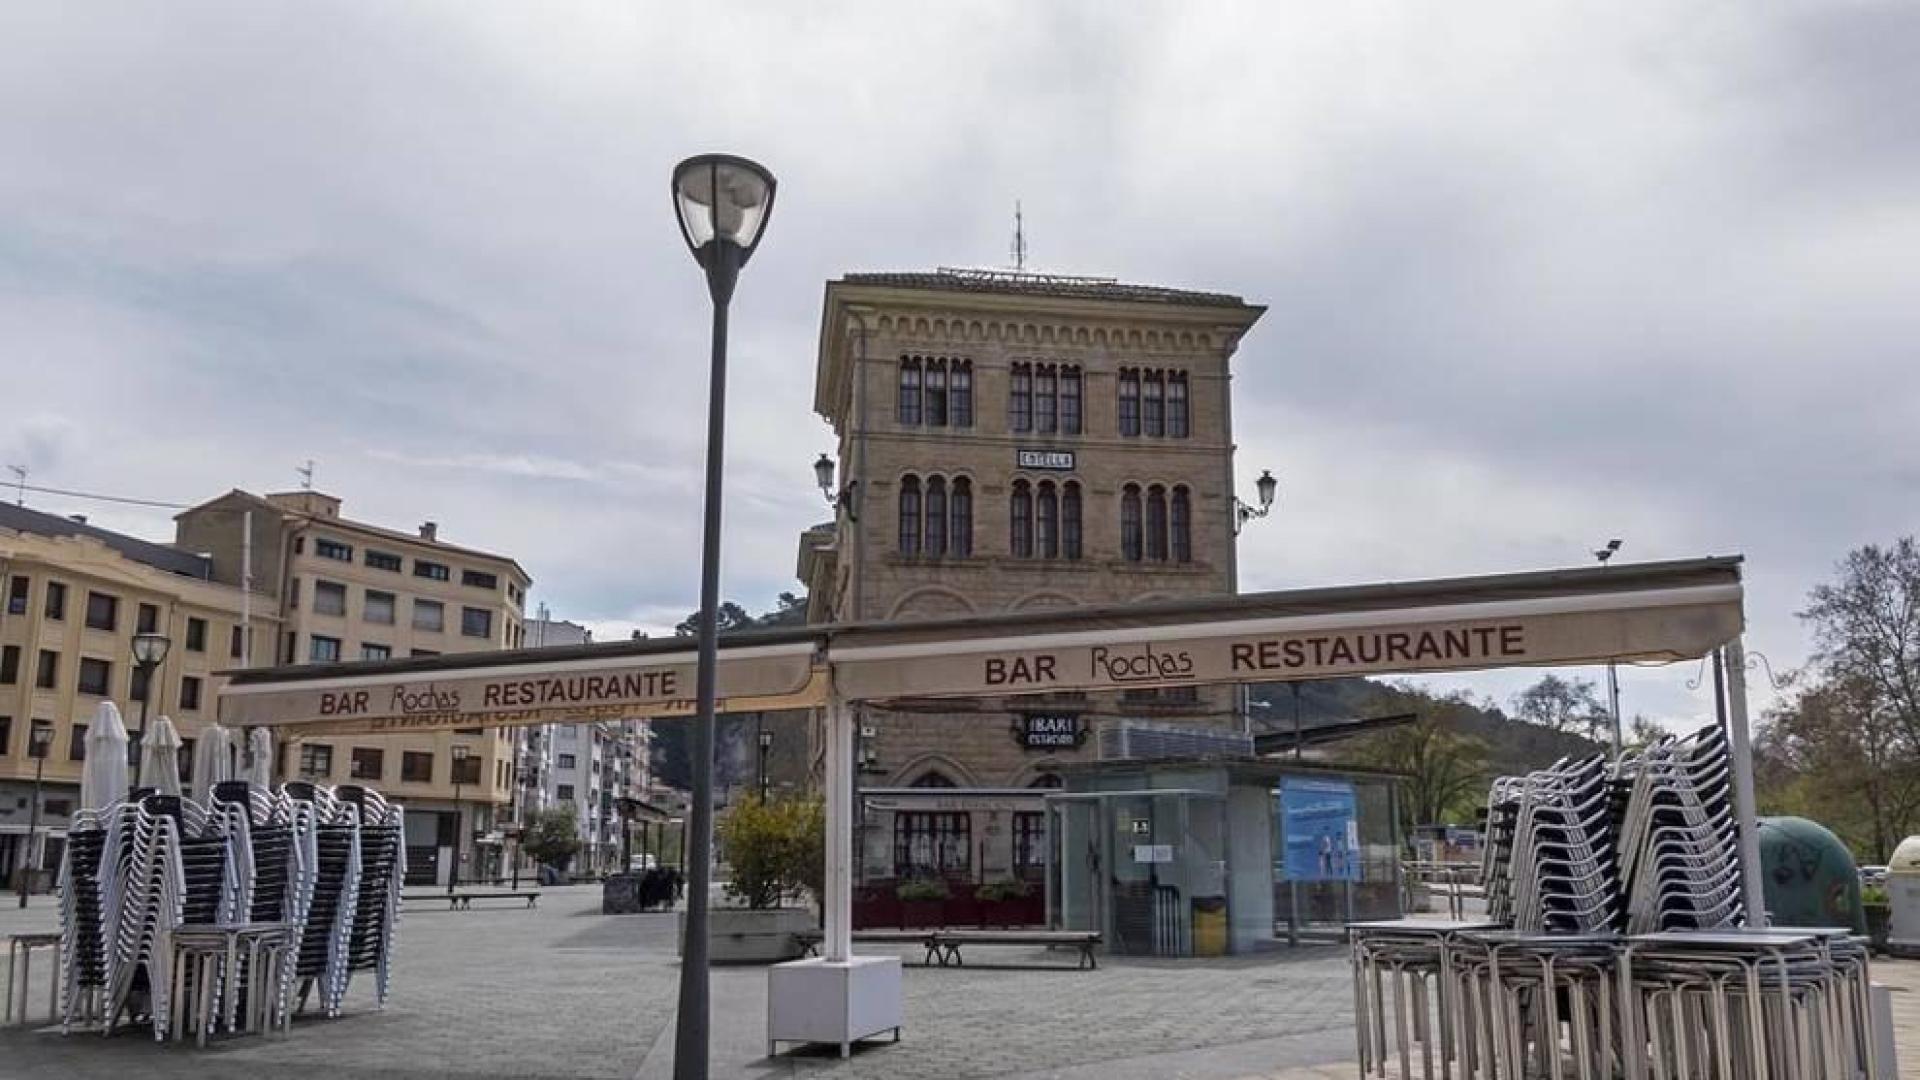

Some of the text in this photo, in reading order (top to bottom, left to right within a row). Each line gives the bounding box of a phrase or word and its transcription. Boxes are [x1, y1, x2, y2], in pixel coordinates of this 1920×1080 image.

[985, 626, 1525, 685] BAR Rochas RESTAURANTE
[320, 691, 369, 714] BAR
[484, 671, 677, 707] RESTAURANTE
